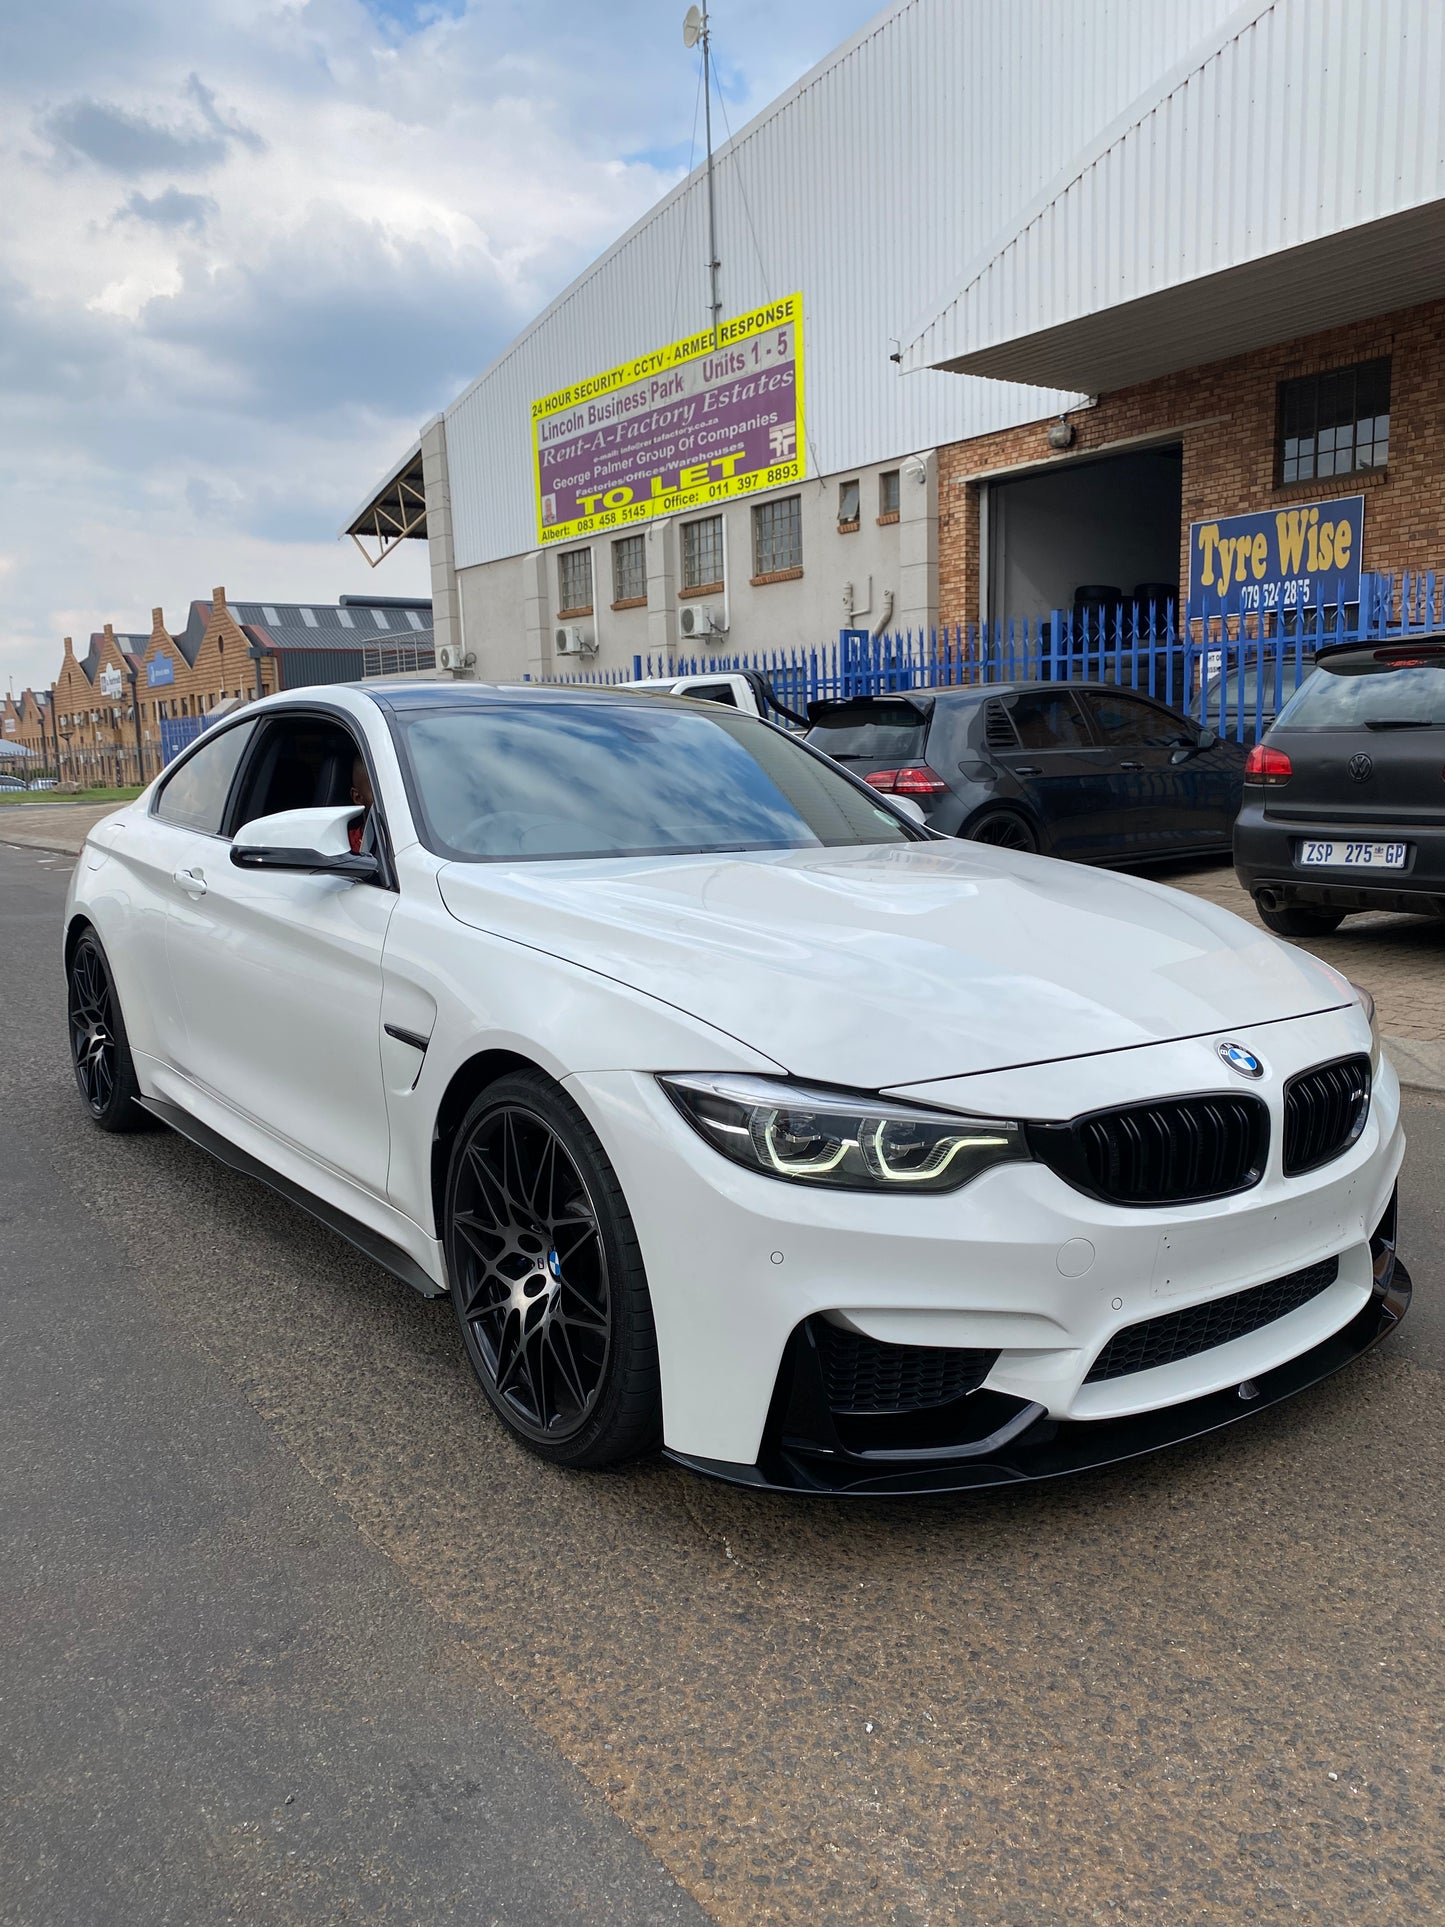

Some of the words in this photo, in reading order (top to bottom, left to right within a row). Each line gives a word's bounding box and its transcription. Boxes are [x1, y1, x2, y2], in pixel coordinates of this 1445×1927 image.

[531, 402, 543, 418] 24
[545, 391, 572, 412] HOUR
[574, 368, 625, 400] SECURITY
[634, 352, 664, 376] CCTV
[674, 331, 716, 361] ARMED
[721, 300, 794, 342] RESPONSE
[541, 411, 584, 442] Lincoln
[588, 390, 647, 425] Business
[651, 372, 684, 402] Park
[702, 351, 746, 383] Units
[751, 341, 759, 365] 1
[777, 330, 788, 356] 5
[542, 401, 696, 468] Rent-A-Factory
[702, 369, 794, 413] Estates
[552, 471, 591, 490] George
[593, 457, 634, 478] Palmer
[636, 445, 675, 465] Group
[678, 435, 695, 451] Of
[697, 411, 778, 446] Companies
[541, 526, 571, 541] Albert:
[577, 518, 594, 532] 083
[599, 512, 616, 526] 458
[622, 504, 646, 521] 5145
[663, 493, 699, 509] Office:
[709, 482, 729, 497] 011
[737, 474, 759, 491] 397
[767, 463, 799, 483] 8893
[575, 441, 745, 498] Factories/Offices/Warehouses
[575, 486, 634, 516] TO
[650, 451, 746, 498] LET
[1198, 524, 1268, 598] Tyre
[1275, 507, 1353, 576] Wise
[1306, 843, 1334, 863] ZSP
[1344, 843, 1374, 863] 275
[1385, 844, 1404, 864] GP
